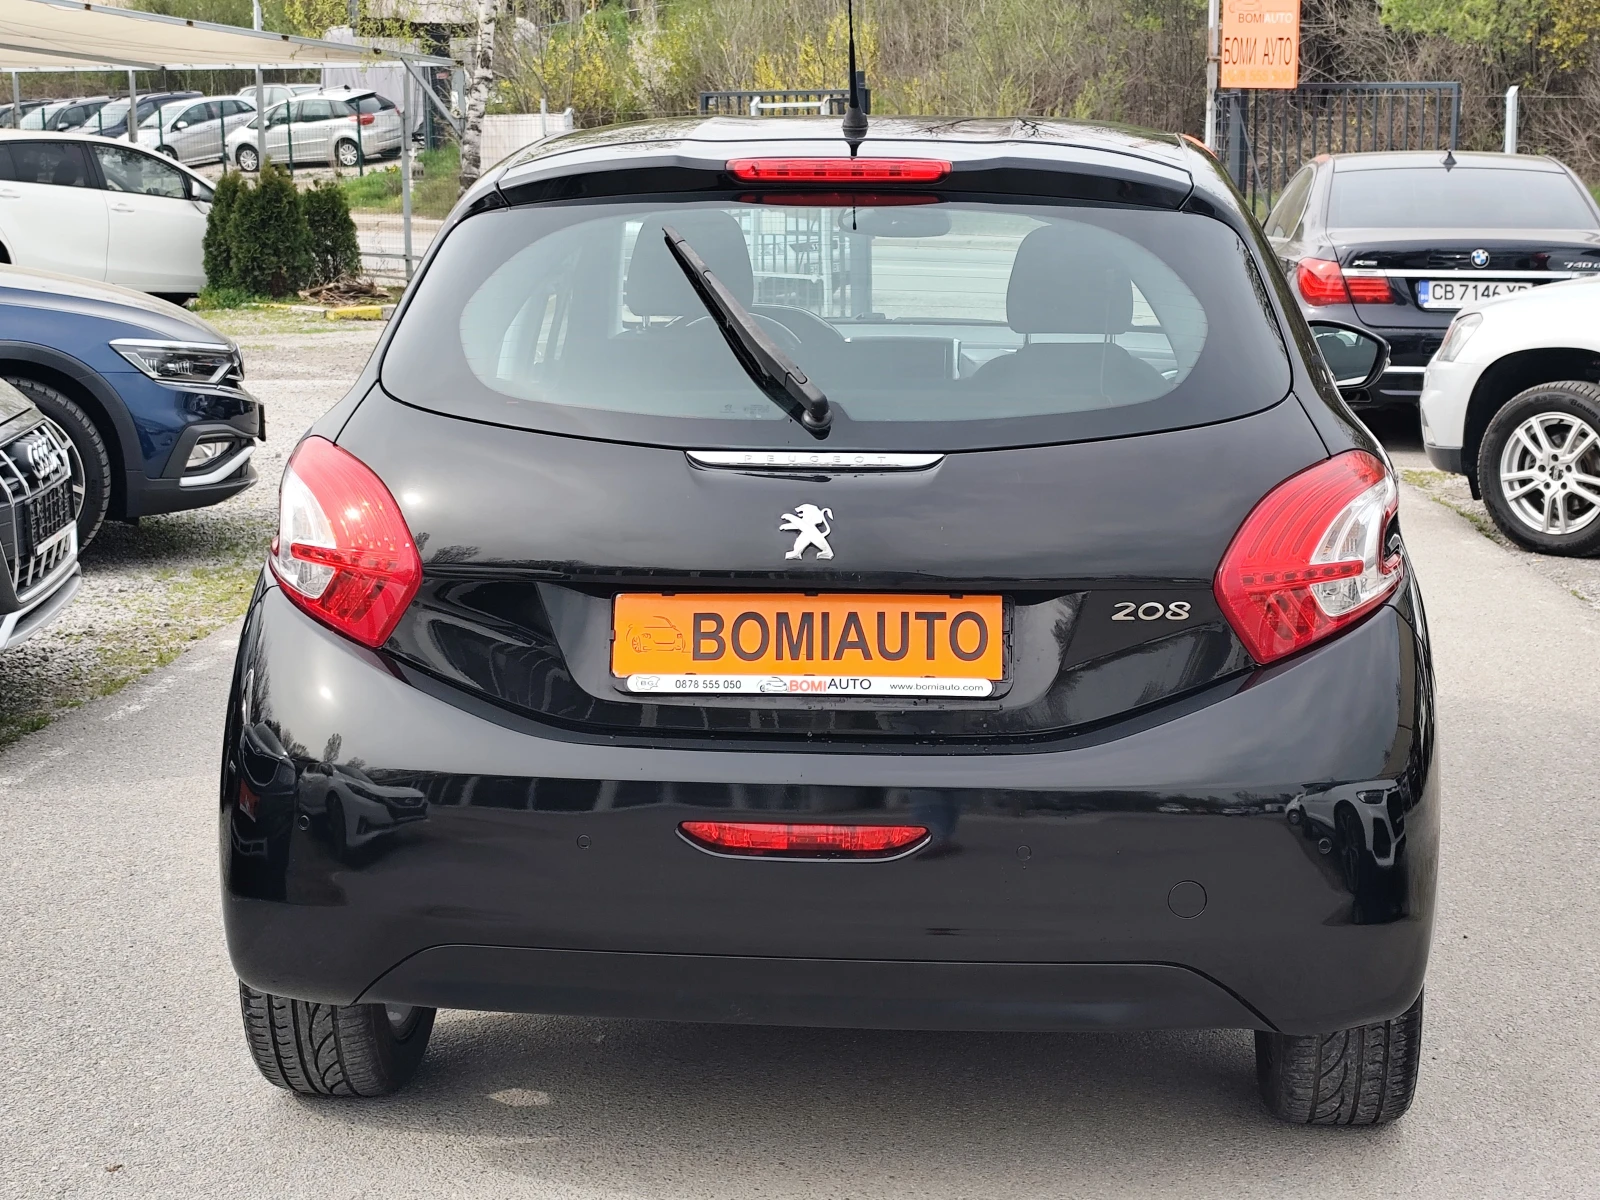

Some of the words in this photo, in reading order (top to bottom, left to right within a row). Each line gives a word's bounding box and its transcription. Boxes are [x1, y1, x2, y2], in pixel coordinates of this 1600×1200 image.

[1238, 13, 1293, 24] BOMIAUTO
[1224, 37, 1257, 65] БОМИ
[1262, 37, 1292, 65] АУТО
[1432, 283, 1455, 301] CB
[744, 454, 886, 464] PEUGEOT
[1111, 601, 1192, 621] 208
[692, 611, 988, 662] BOMIAUTO
[675, 680, 699, 689] 0878
[703, 680, 720, 689] 555
[723, 680, 742, 689] 050
[890, 682, 984, 692] www.bomiauto.com
